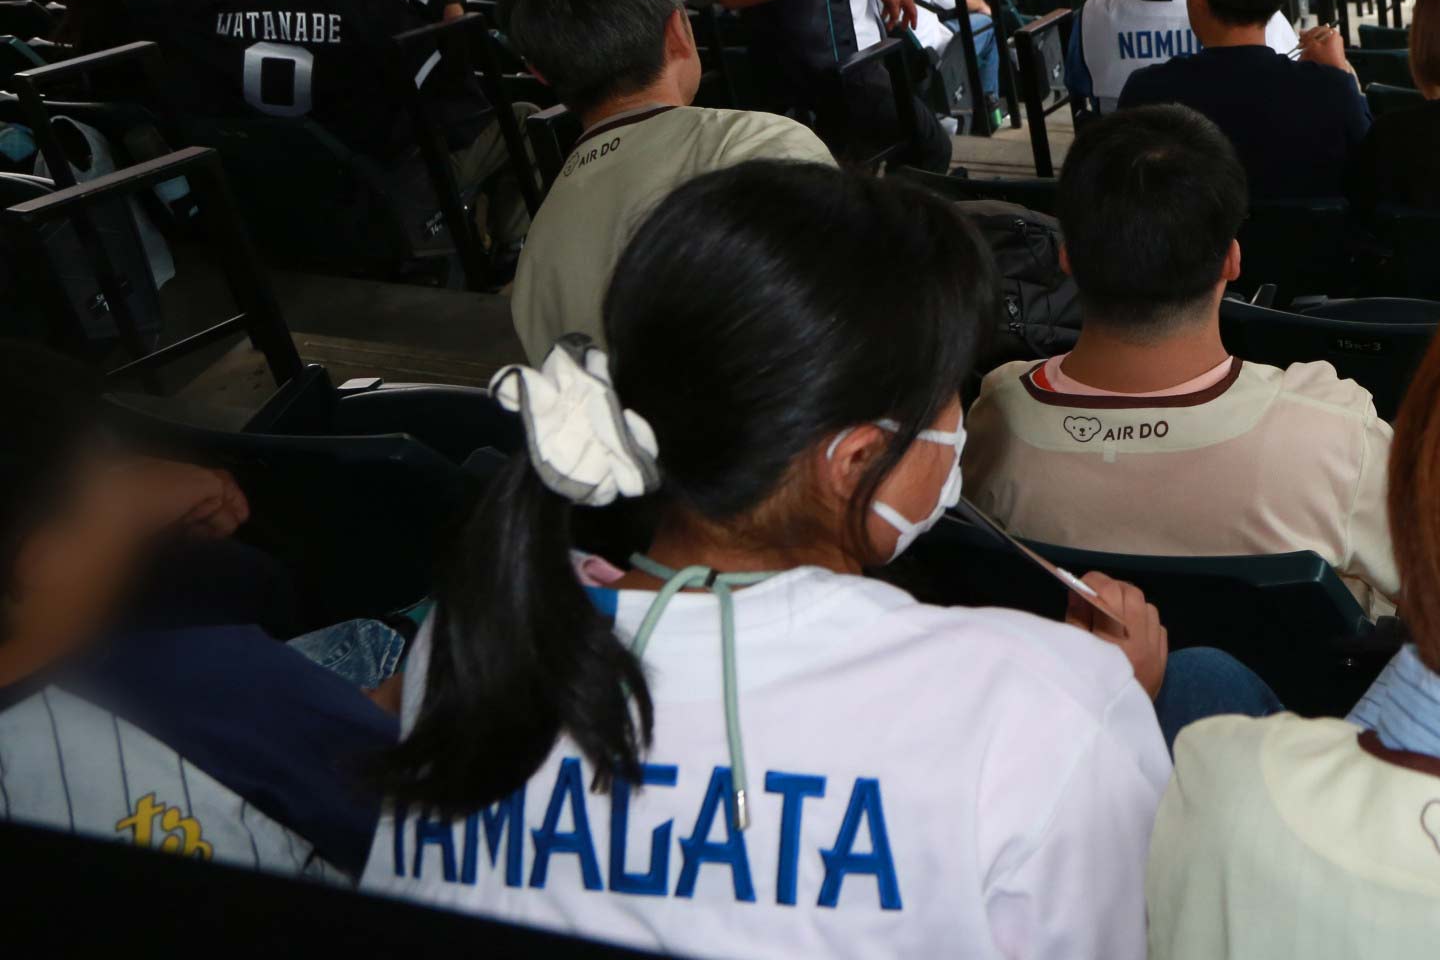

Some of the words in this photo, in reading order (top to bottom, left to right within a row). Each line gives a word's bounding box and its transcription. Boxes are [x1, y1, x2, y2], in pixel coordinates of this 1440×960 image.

[216, 10, 342, 43] WATANABE
[1118, 29, 1203, 59] NOMU
[578, 149, 598, 168] AIR
[600, 137, 621, 157] DO
[1102, 426, 1134, 441] AIR
[1139, 421, 1169, 439] DO
